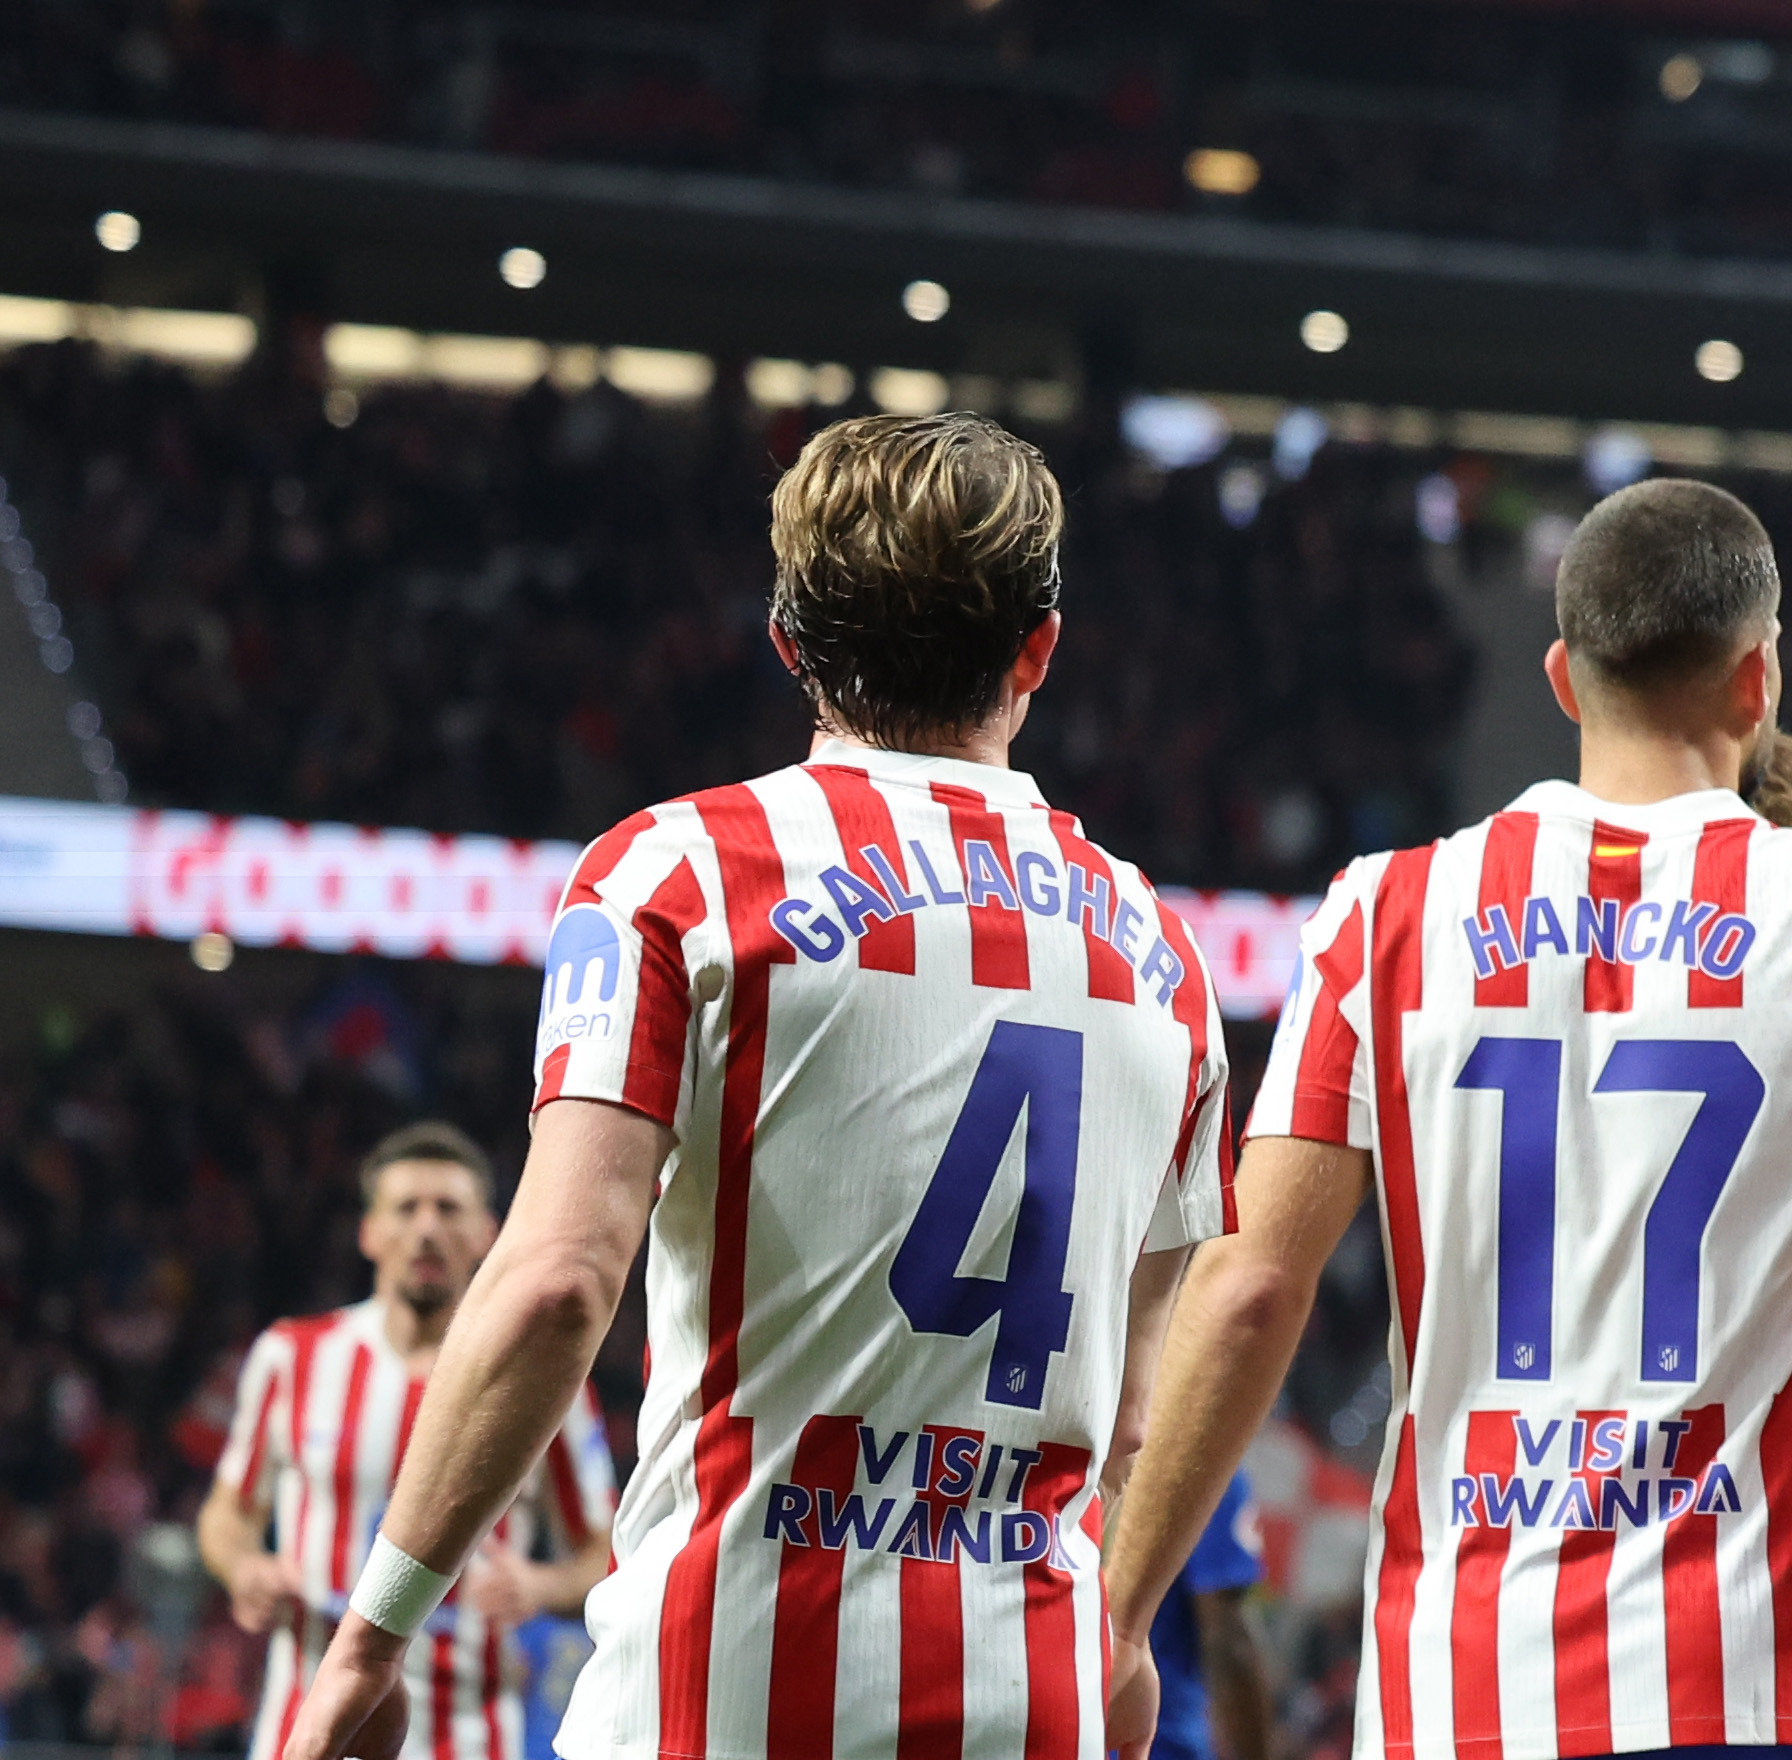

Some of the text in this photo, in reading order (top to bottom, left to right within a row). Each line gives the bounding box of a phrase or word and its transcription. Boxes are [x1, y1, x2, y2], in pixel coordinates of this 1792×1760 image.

[769, 838, 1185, 1007] GALLAGHER
[1461, 894, 1757, 981] HANCKO
[889, 1019, 1084, 1411] 4
[1453, 1036, 1766, 1383] 17
[858, 1423, 1042, 1504] VISIT
[1515, 1418, 1690, 1472] VISIT
[1450, 1460, 1743, 1530] RWANDA
